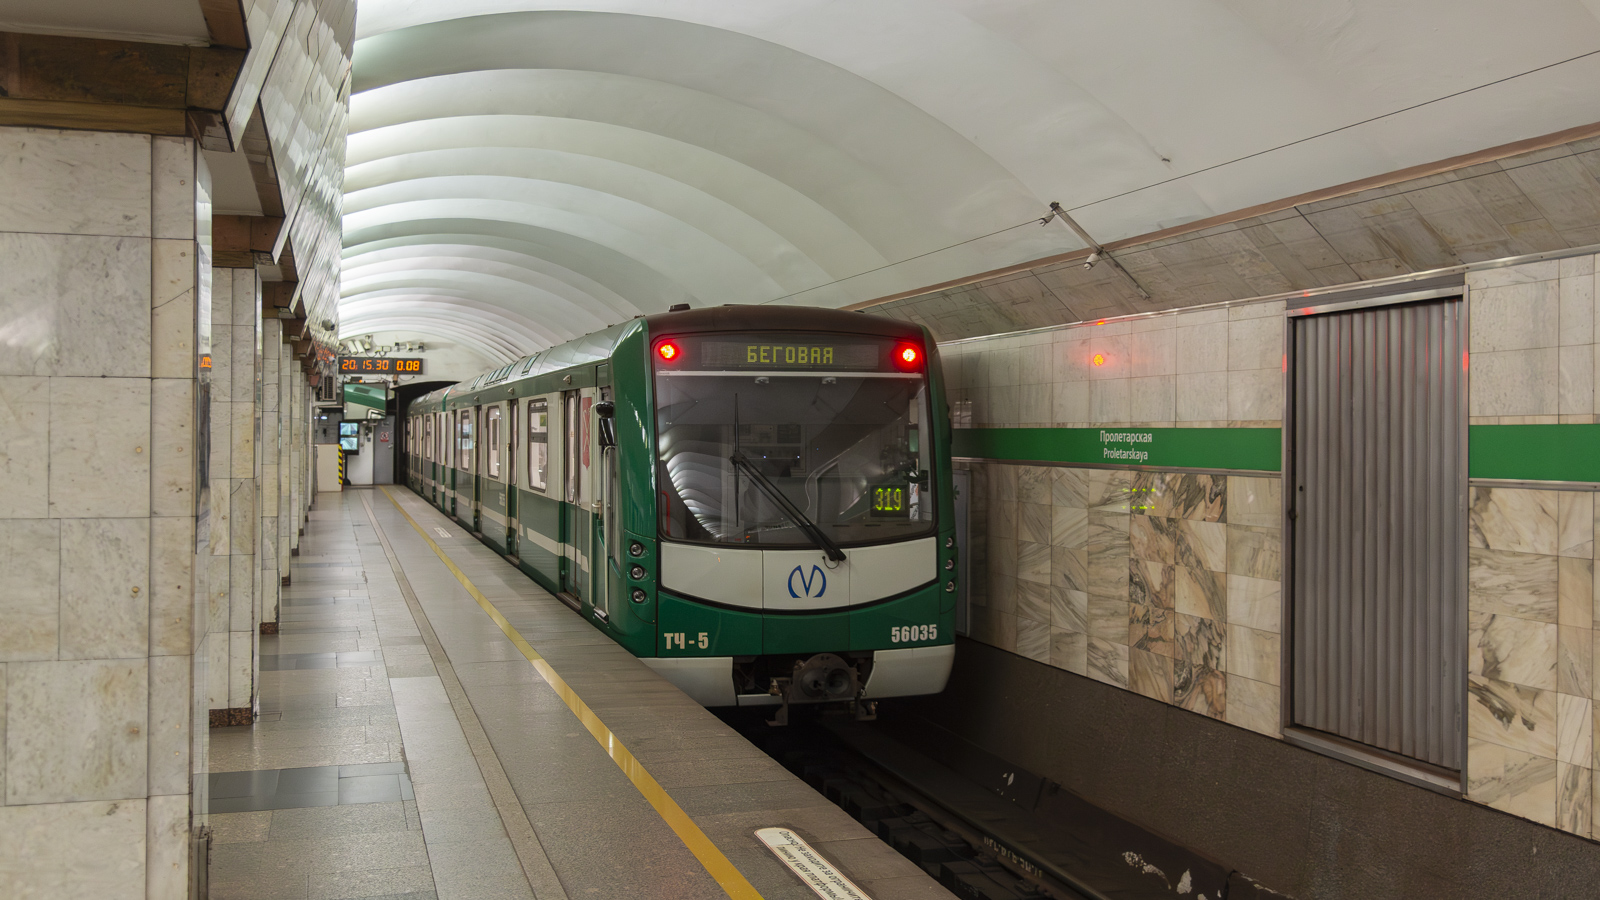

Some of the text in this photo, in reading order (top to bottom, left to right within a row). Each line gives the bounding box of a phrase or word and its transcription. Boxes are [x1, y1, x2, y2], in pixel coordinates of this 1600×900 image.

[747, 345, 834, 364] БЕГОВАЯ
[396, 360, 420, 371] 0.08
[1099, 430, 1153, 446] Пролетарская
[1103, 447, 1149, 463] Proletarskaya
[875, 488, 902, 511] 319
[891, 624, 938, 643] 56035
